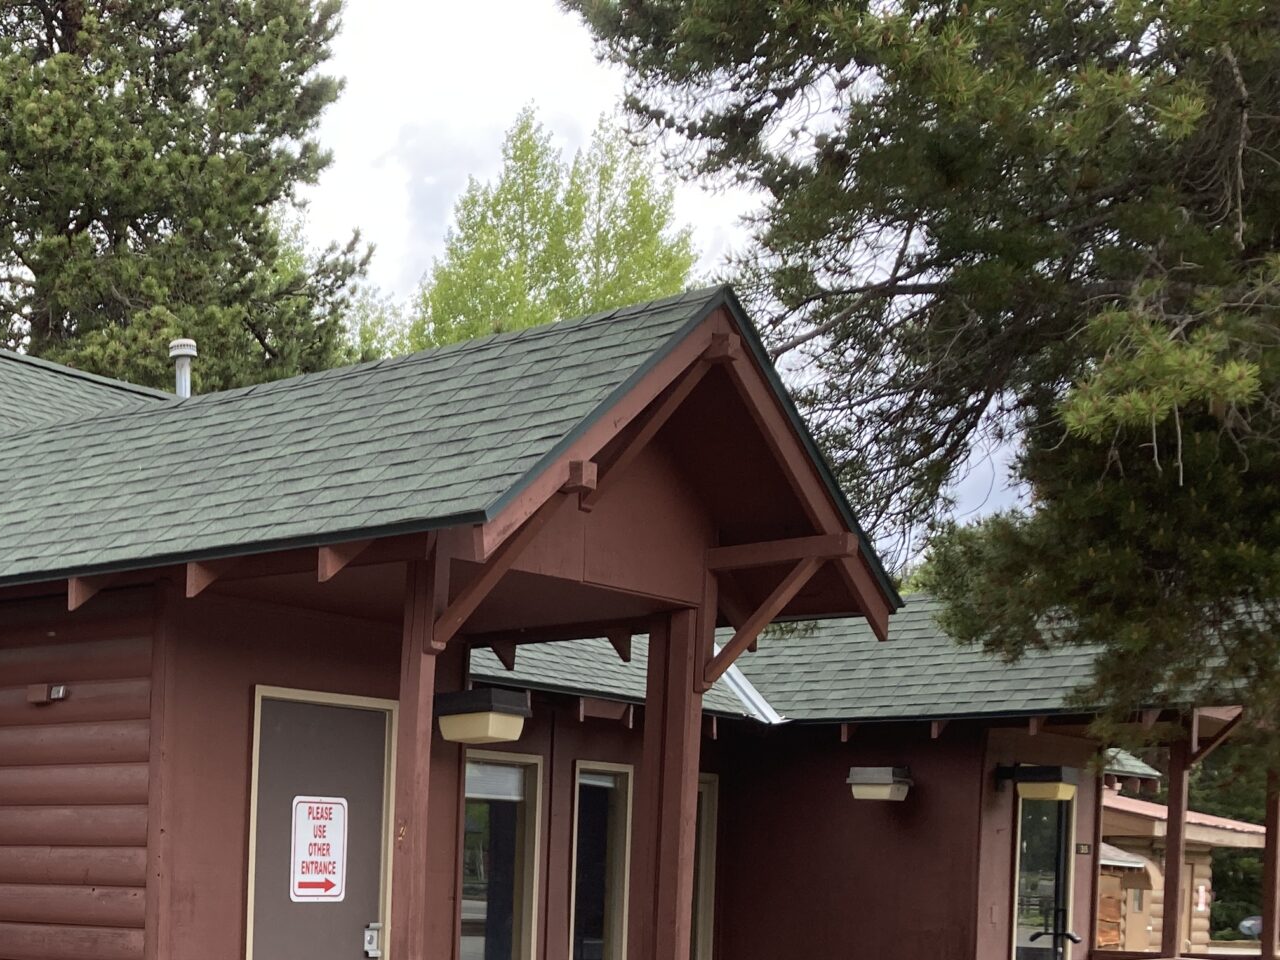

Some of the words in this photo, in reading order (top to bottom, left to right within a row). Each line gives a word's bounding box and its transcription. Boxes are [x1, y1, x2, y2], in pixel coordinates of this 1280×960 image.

[307, 806, 333, 821] PLEASE
[313, 825, 327, 839] USE
[308, 843, 331, 857] OTHER
[301, 861, 336, 875] ENTRANCE
